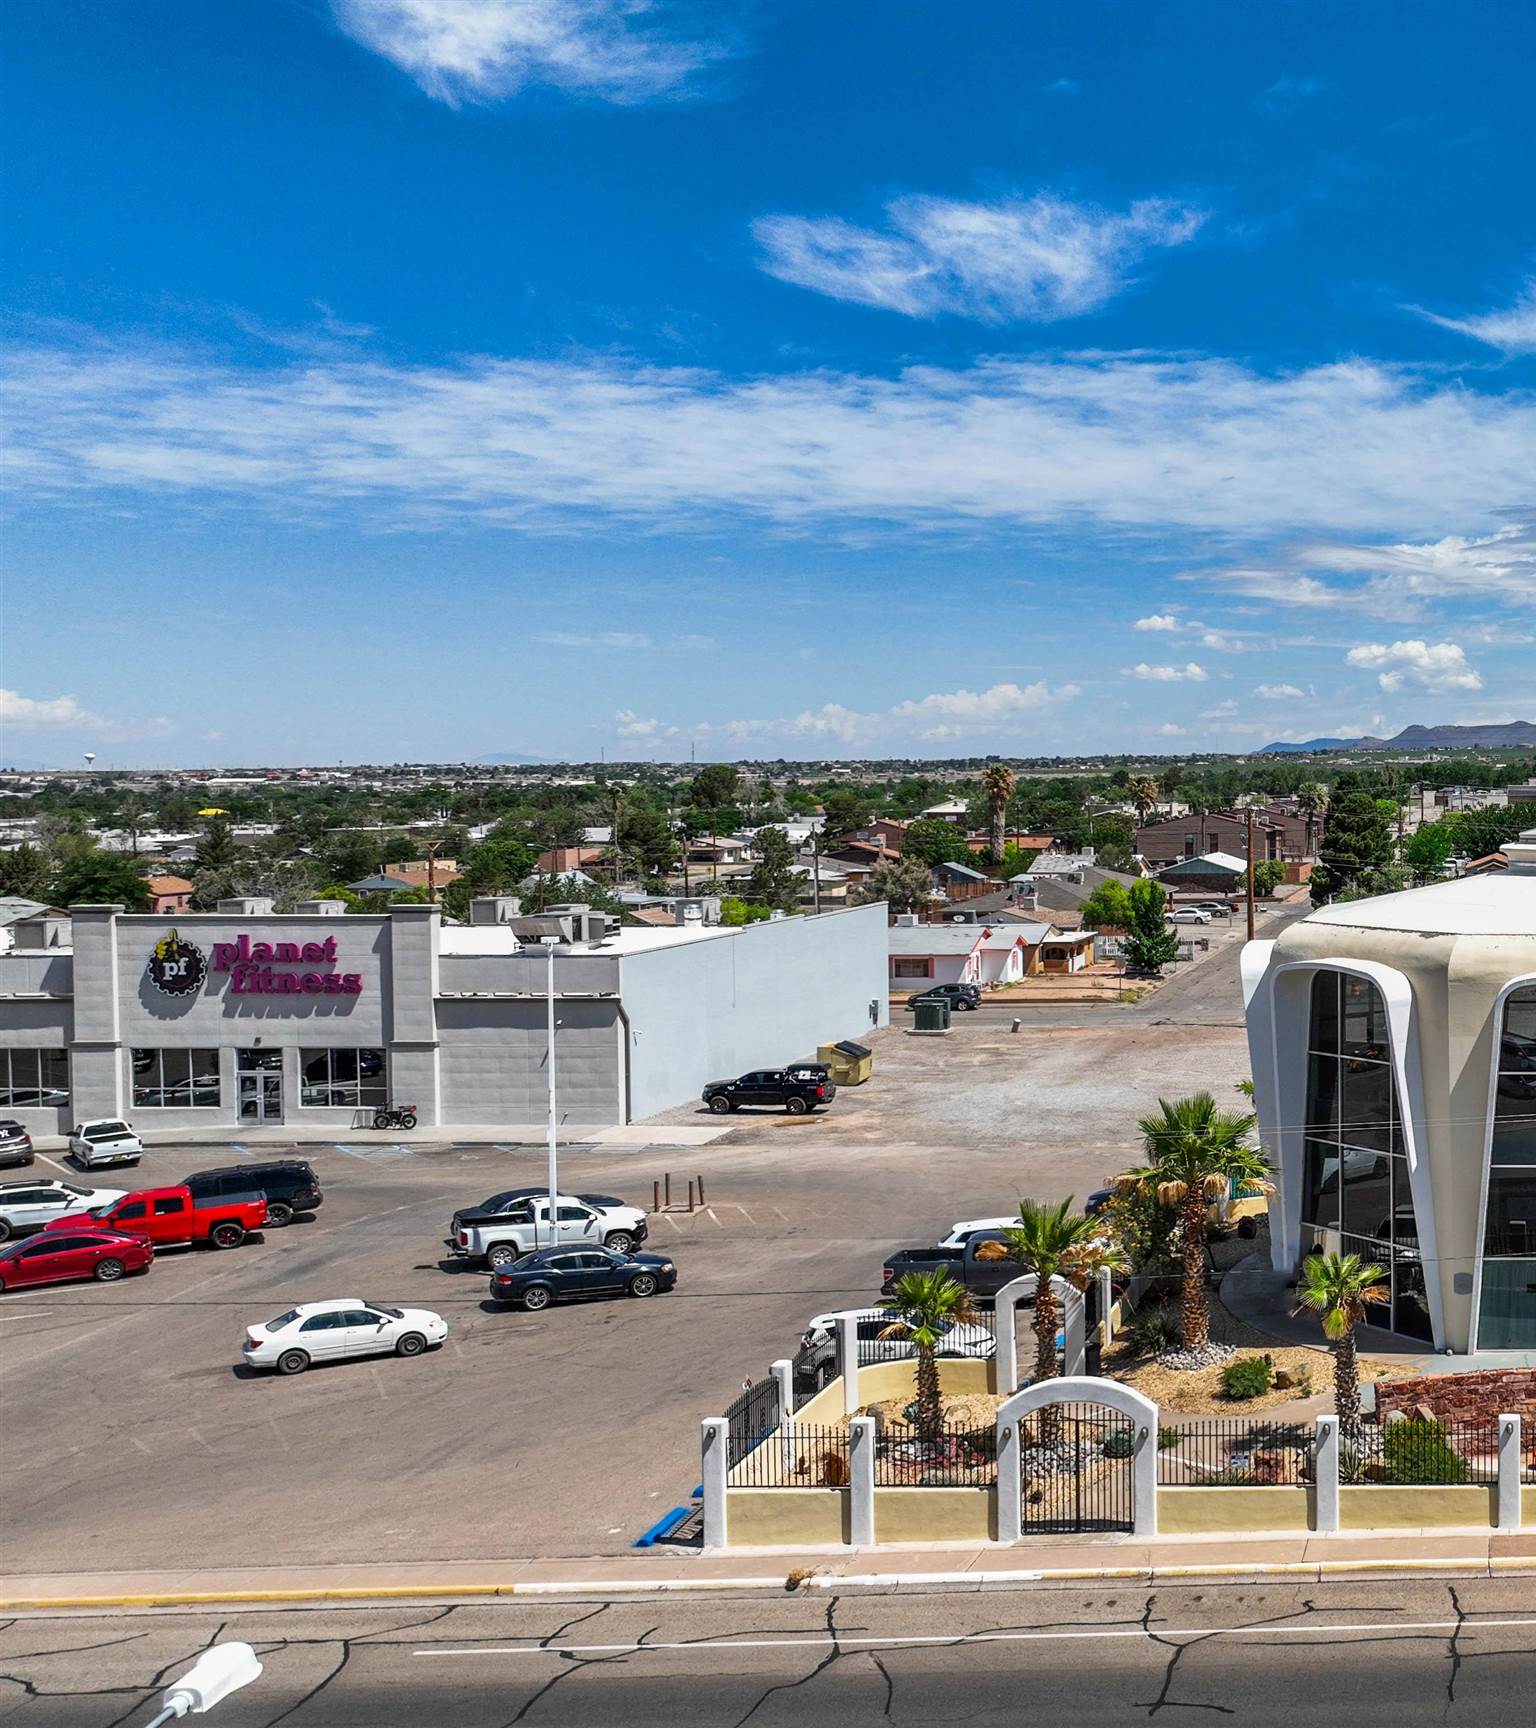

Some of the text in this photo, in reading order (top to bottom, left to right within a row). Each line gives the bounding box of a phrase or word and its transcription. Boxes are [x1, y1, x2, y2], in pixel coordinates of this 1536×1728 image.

[213, 934, 338, 972] planet
[163, 958, 189, 981] pf
[231, 964, 363, 994] fitness
